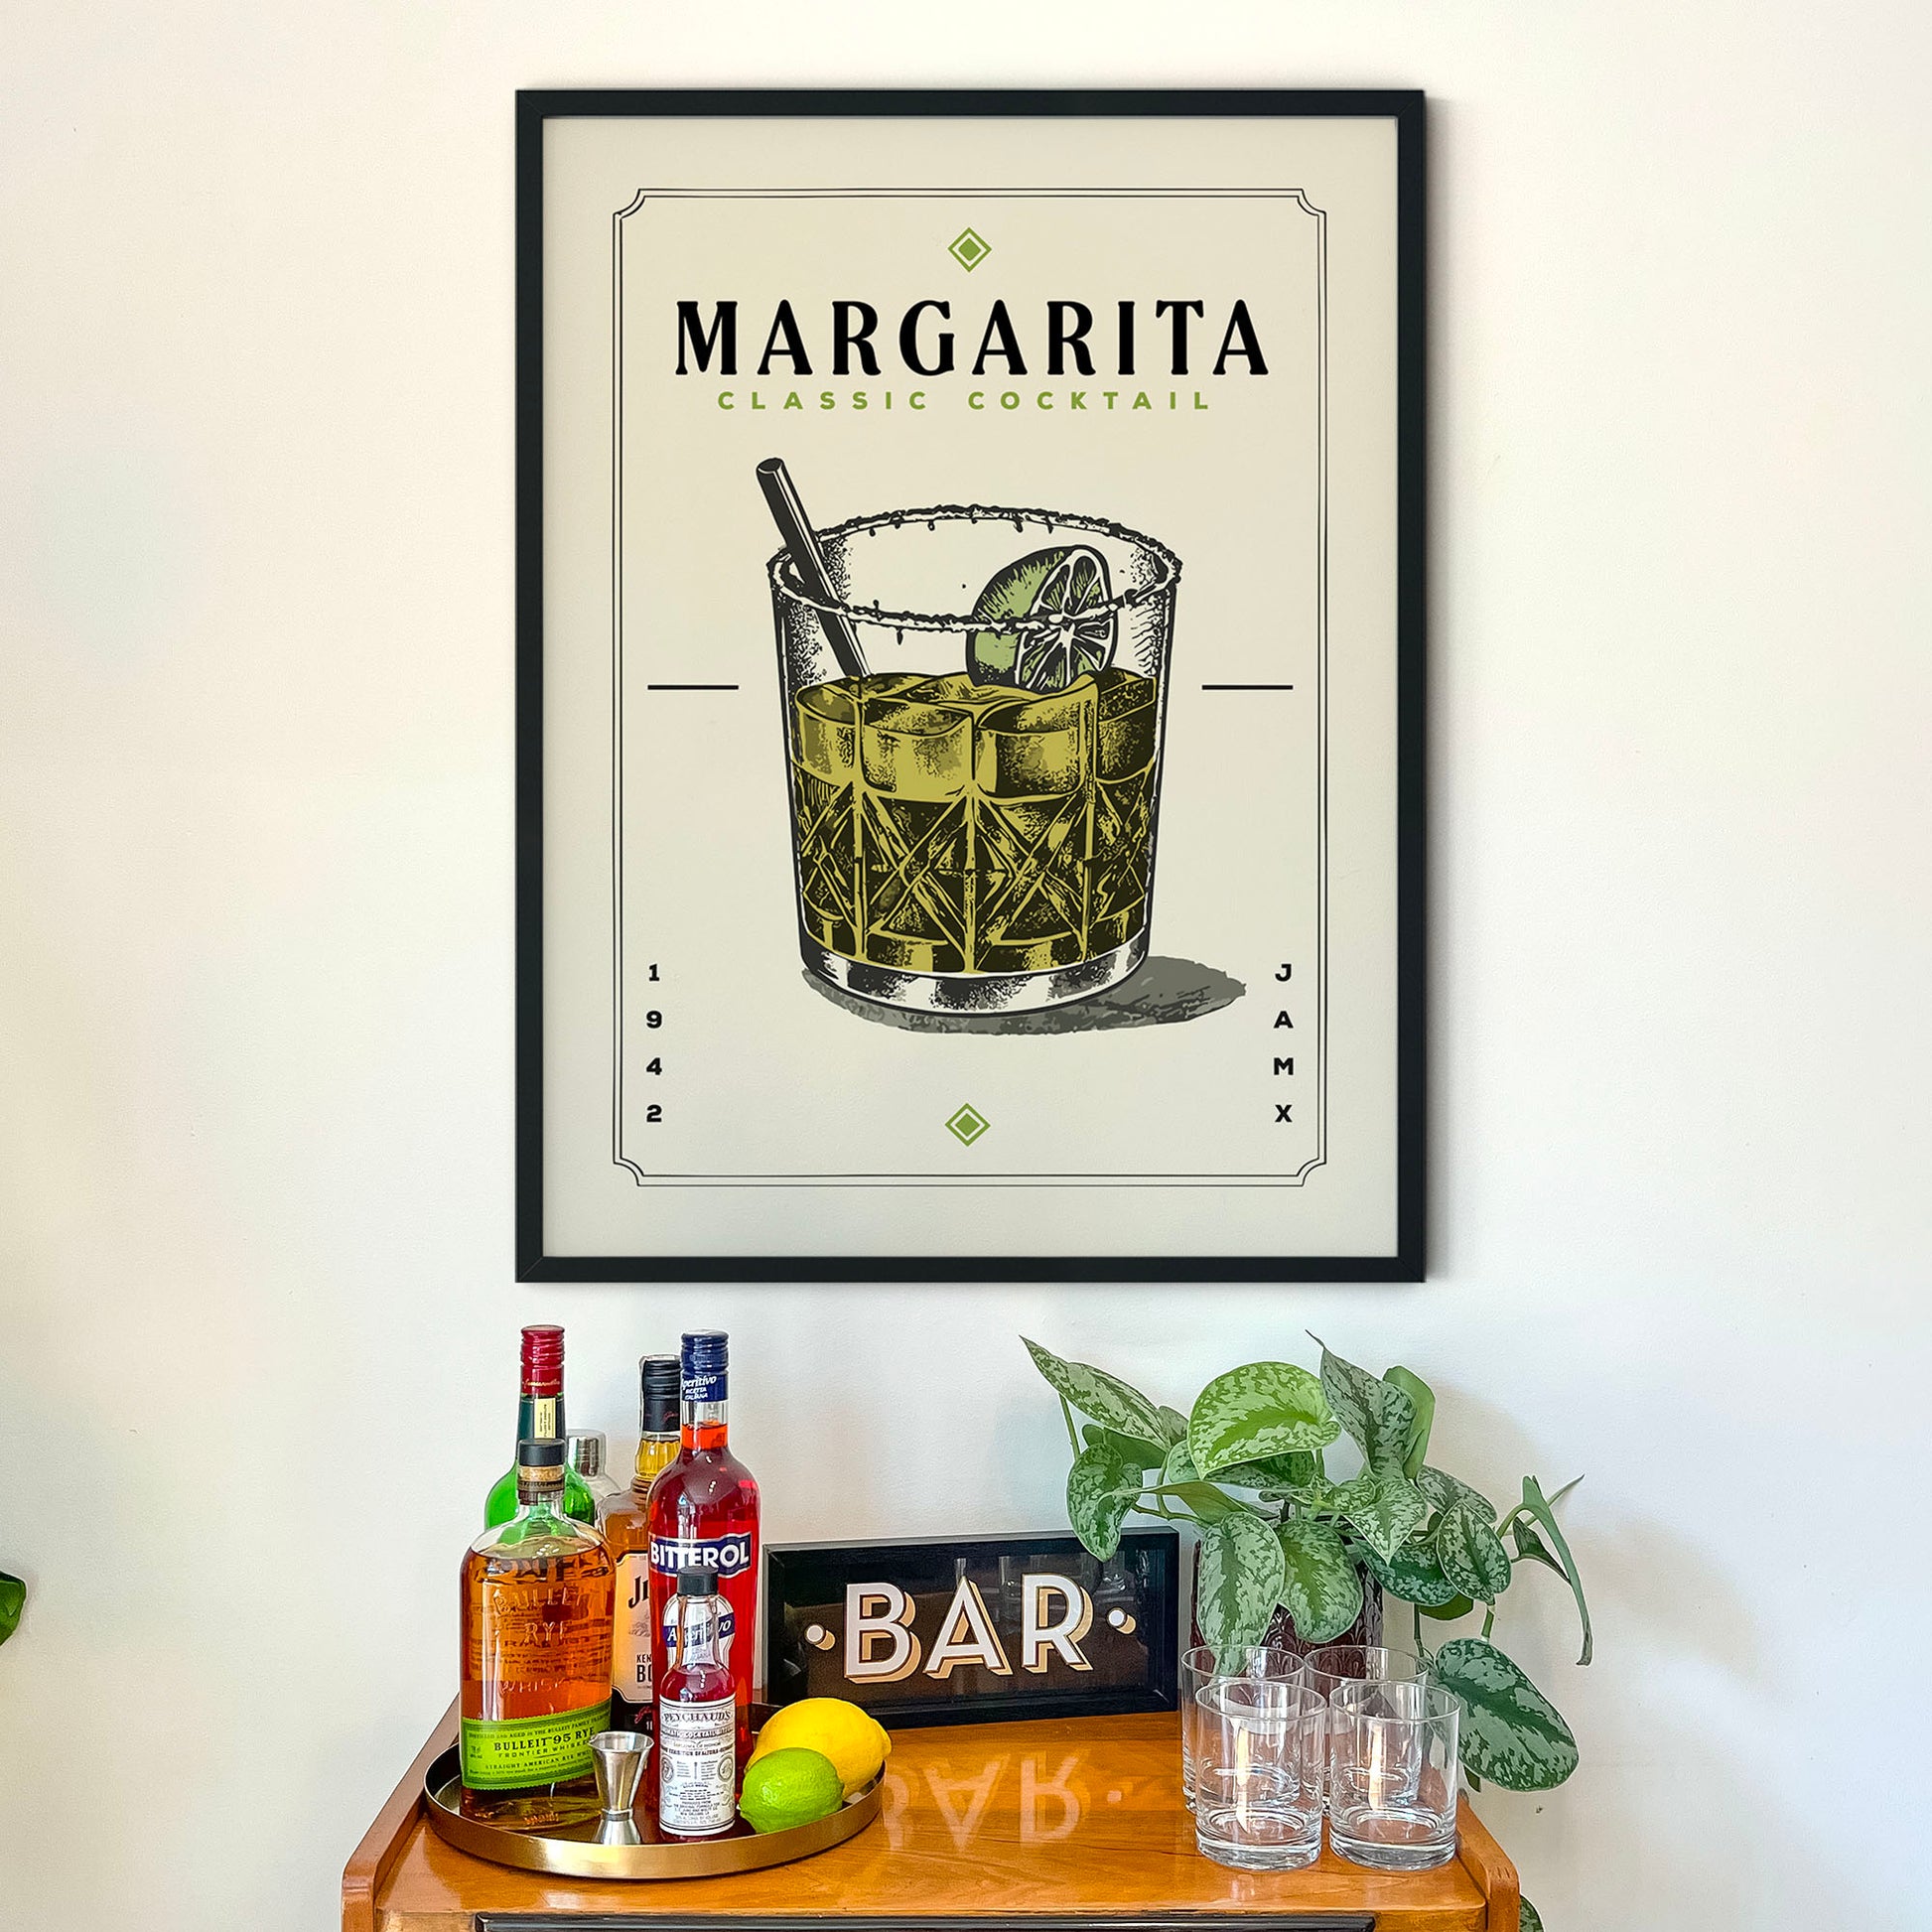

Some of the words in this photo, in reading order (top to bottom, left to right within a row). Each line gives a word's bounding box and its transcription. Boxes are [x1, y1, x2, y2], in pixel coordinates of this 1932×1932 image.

[675, 299, 1269, 377] MARGARITA
[718, 391, 929, 410] CLASSIC
[968, 391, 1210, 410] COCKTAIL
[650, 1542, 750, 1569] BITTEROL
[844, 1572, 1094, 1684] BAR
[493, 1737, 549, 1751] BULLEIT
[552, 1733, 572, 1744] 95
[575, 1725, 596, 1739] RYE
[498, 1748, 548, 1758] FRONTIER
[553, 1739, 590, 1751] WHISKE
